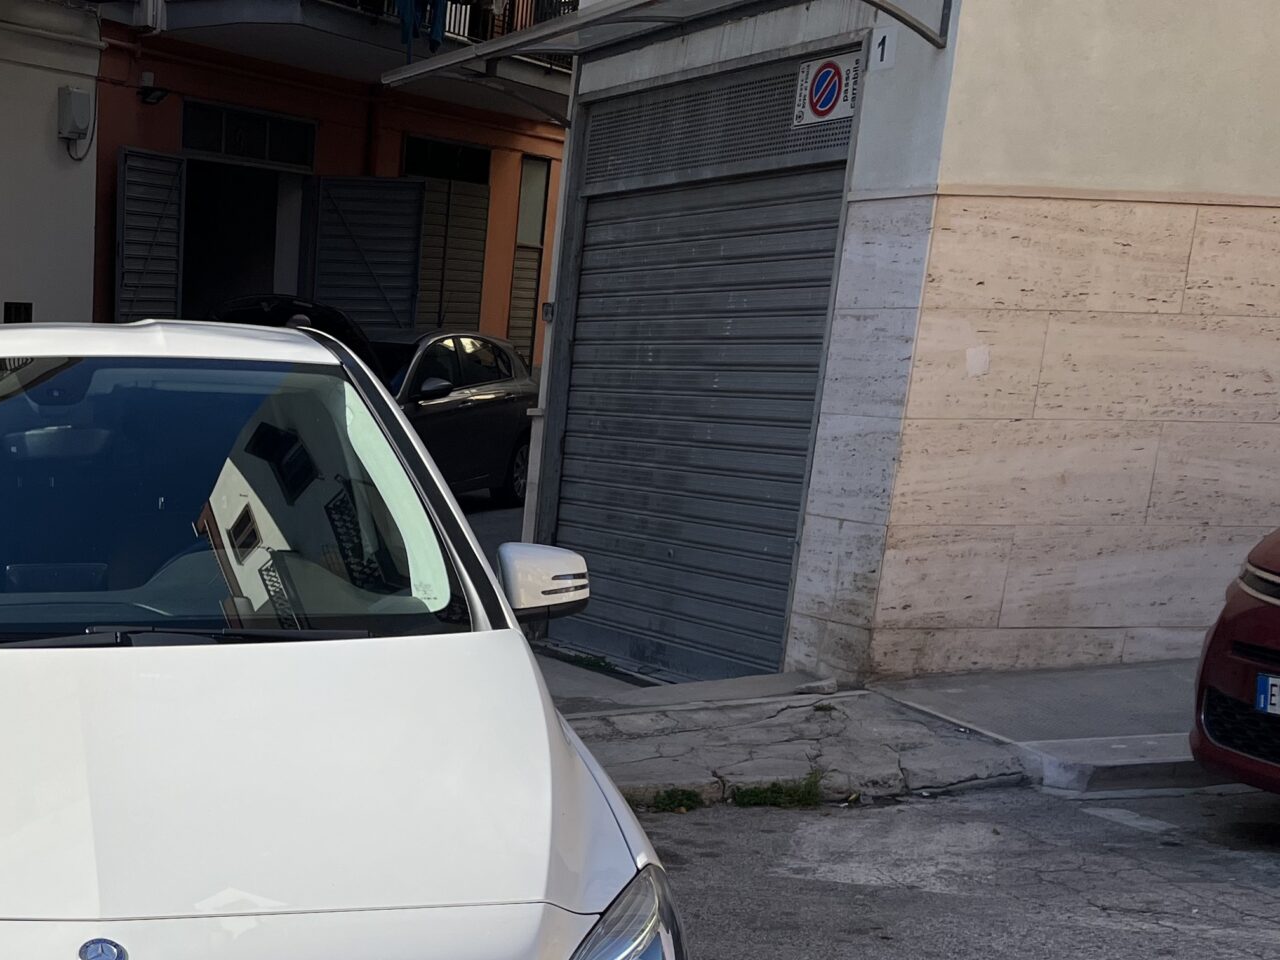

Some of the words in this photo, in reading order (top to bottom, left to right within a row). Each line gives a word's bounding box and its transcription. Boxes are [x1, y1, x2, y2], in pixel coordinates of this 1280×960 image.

[877, 35, 887, 62] 1
[843, 69, 851, 102] passo
[850, 59, 860, 109] carrabile
[1270, 684, 1280, 706] E
